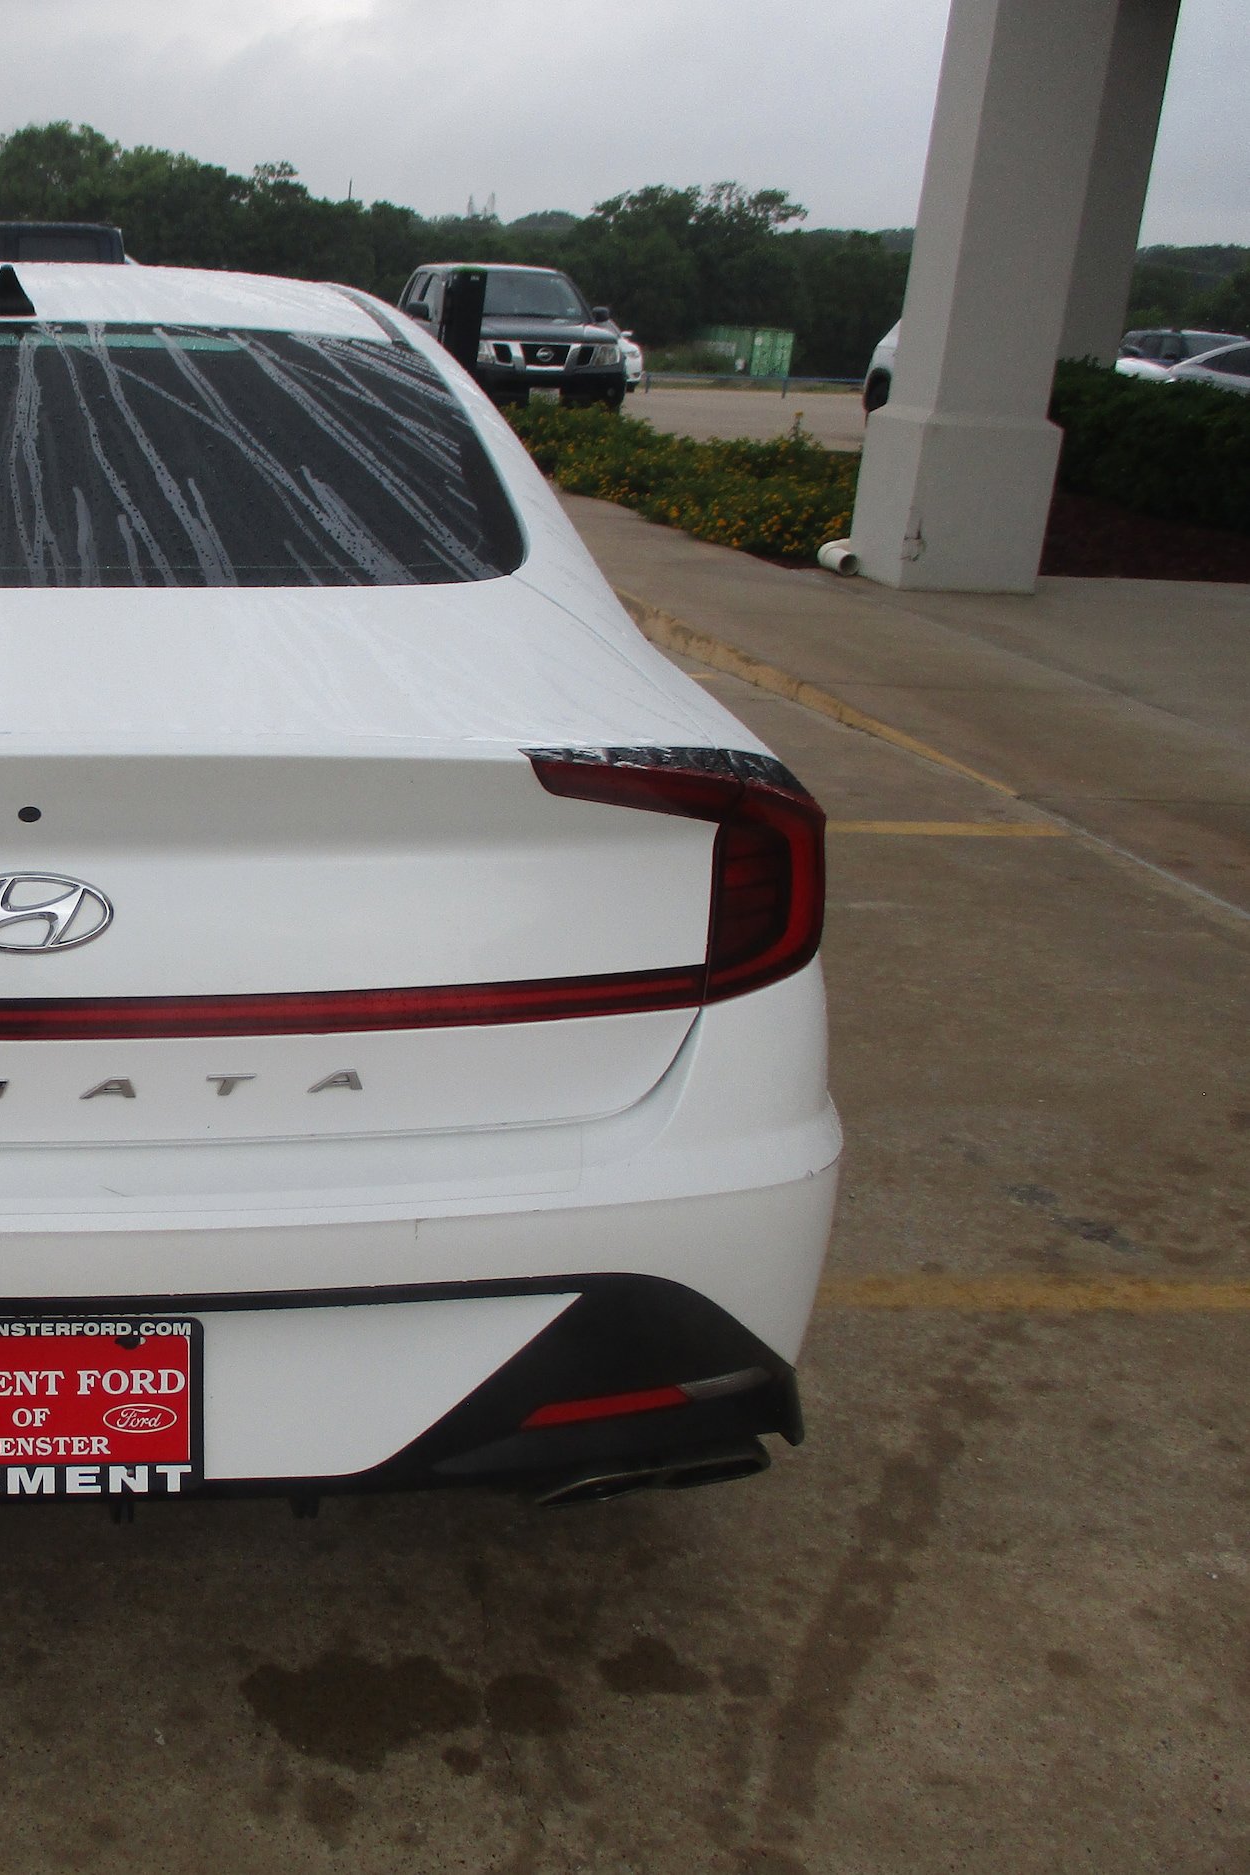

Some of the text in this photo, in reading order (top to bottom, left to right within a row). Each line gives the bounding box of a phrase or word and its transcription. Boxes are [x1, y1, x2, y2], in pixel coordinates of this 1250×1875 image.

[76, 1369, 186, 1395] FORD
[11, 1408, 51, 1428] OF
[115, 1407, 163, 1429] Ford
